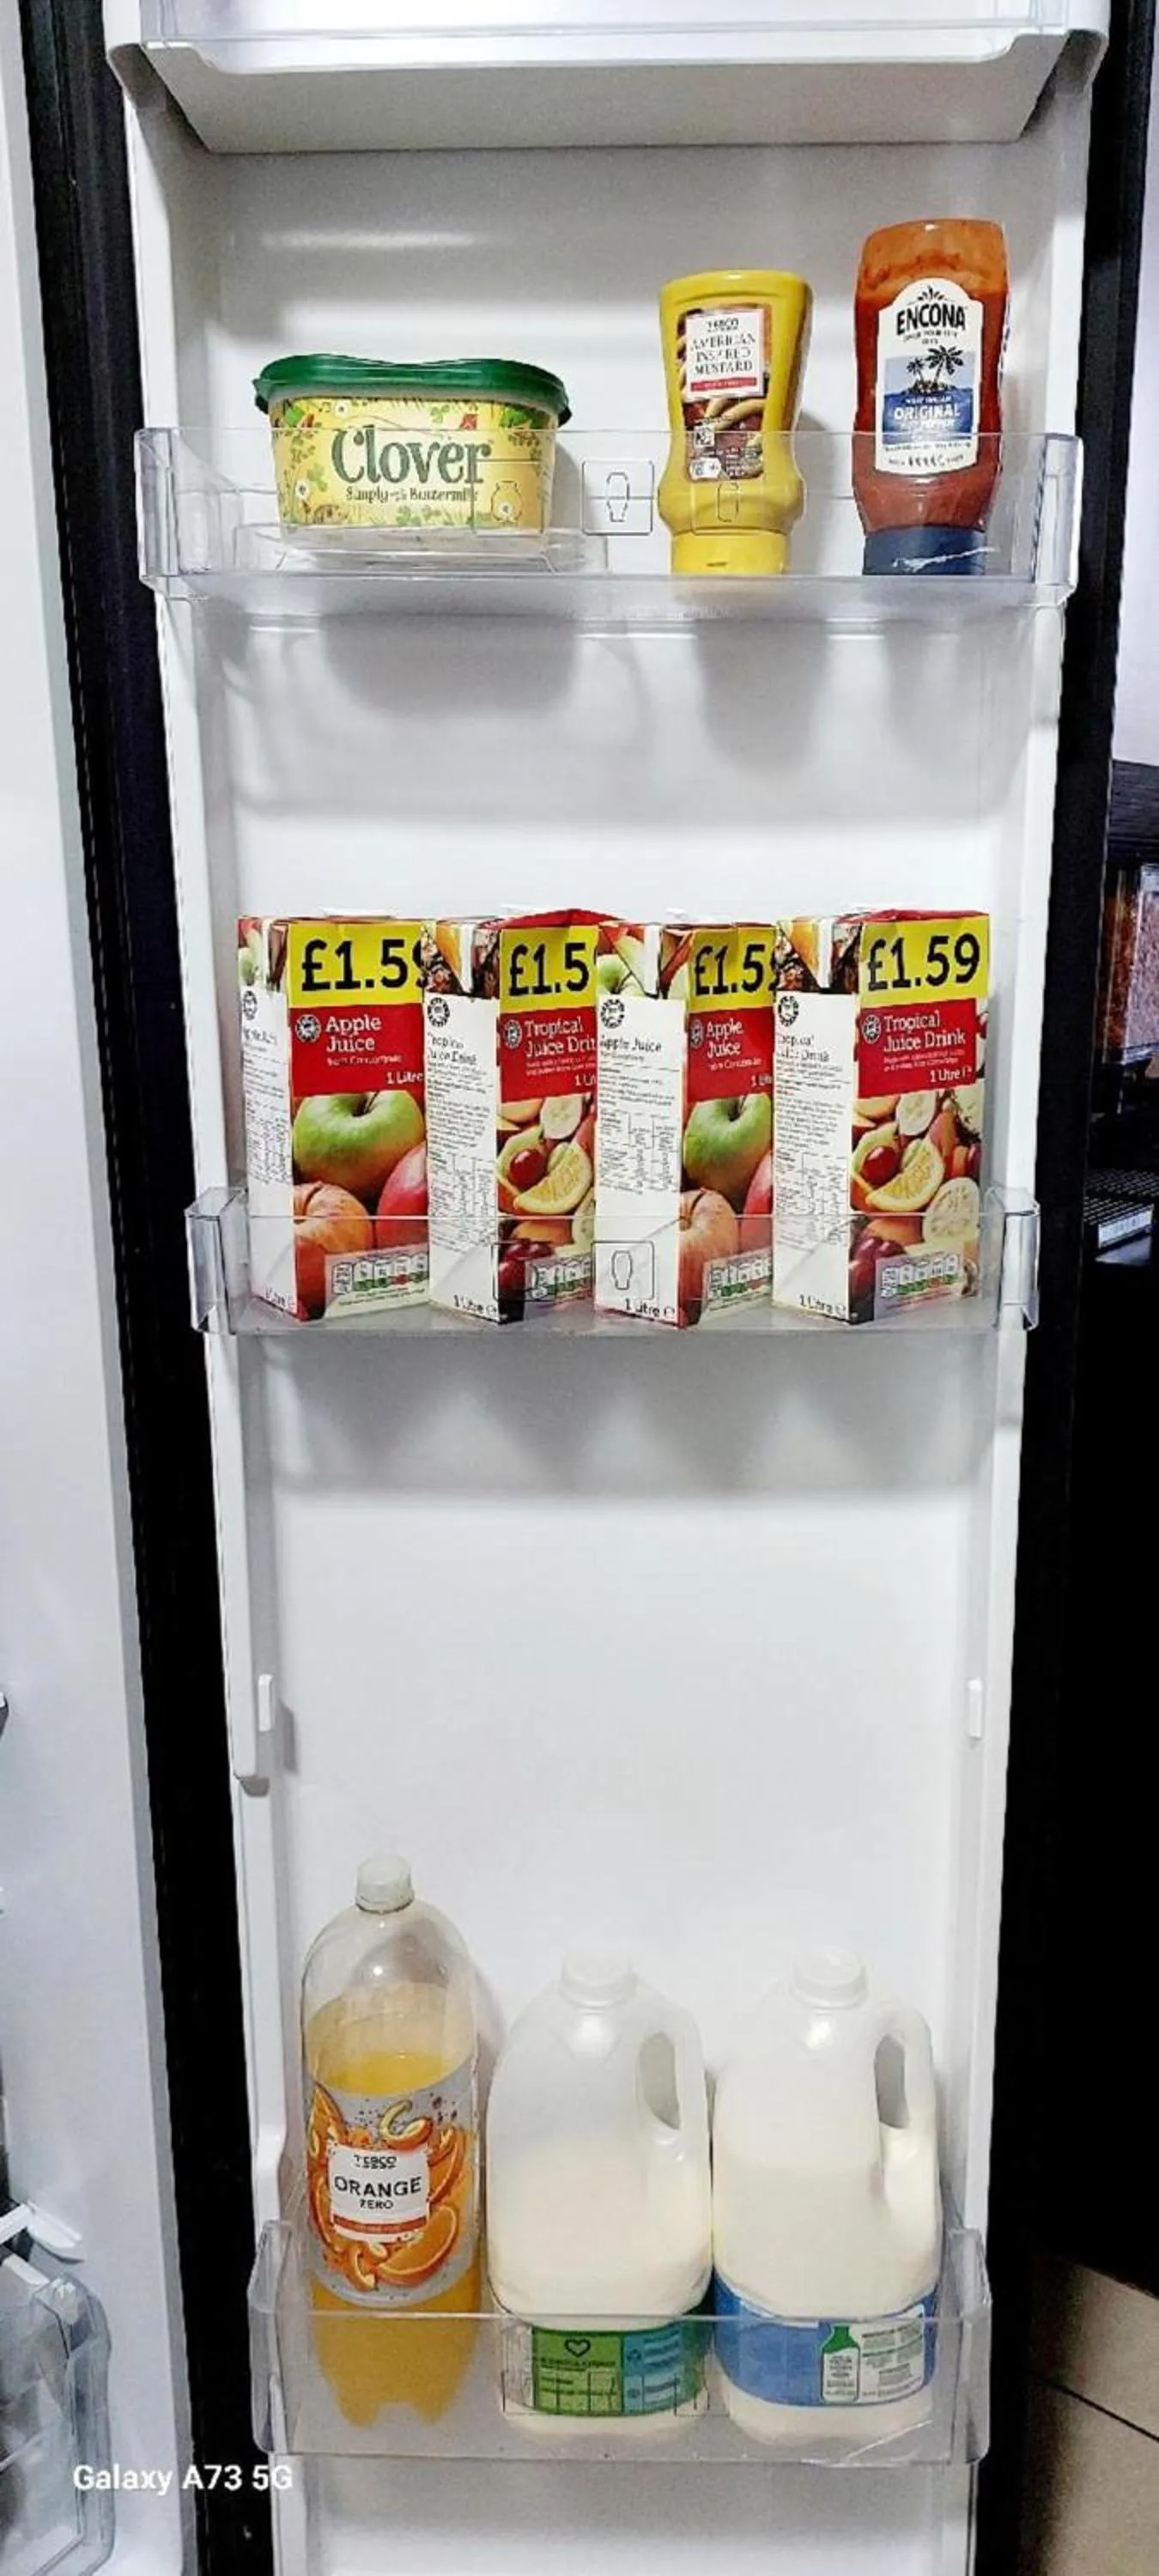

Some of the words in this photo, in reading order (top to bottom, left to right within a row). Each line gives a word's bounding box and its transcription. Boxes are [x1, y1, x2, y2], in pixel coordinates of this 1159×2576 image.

[897, 303, 966, 336] ENCONA
[695, 361, 753, 376] MUSTARD
[894, 402, 961, 421] ORIGINAL
[331, 424, 492, 483] Clover
[509, 943, 598, 996] £1.5
[868, 933, 980, 991] £1.59
[325, 1014, 382, 1036] Apple
[525, 1016, 584, 1039] Tropical
[707, 1018, 744, 1040] Apple
[883, 1010, 940, 1034] Tropical
[326, 1035, 375, 1052] Juice
[525, 1041, 564, 1057] Juice
[707, 1040, 742, 1058] Juice
[883, 1034, 921, 1053] Juice
[925, 1028, 966, 1048] Drink
[387, 1072, 393, 1084] 1
[353, 2154, 397, 2170] TESCO
[335, 2175, 422, 2198] ORANGE
[360, 2199, 394, 2210] ZERO
